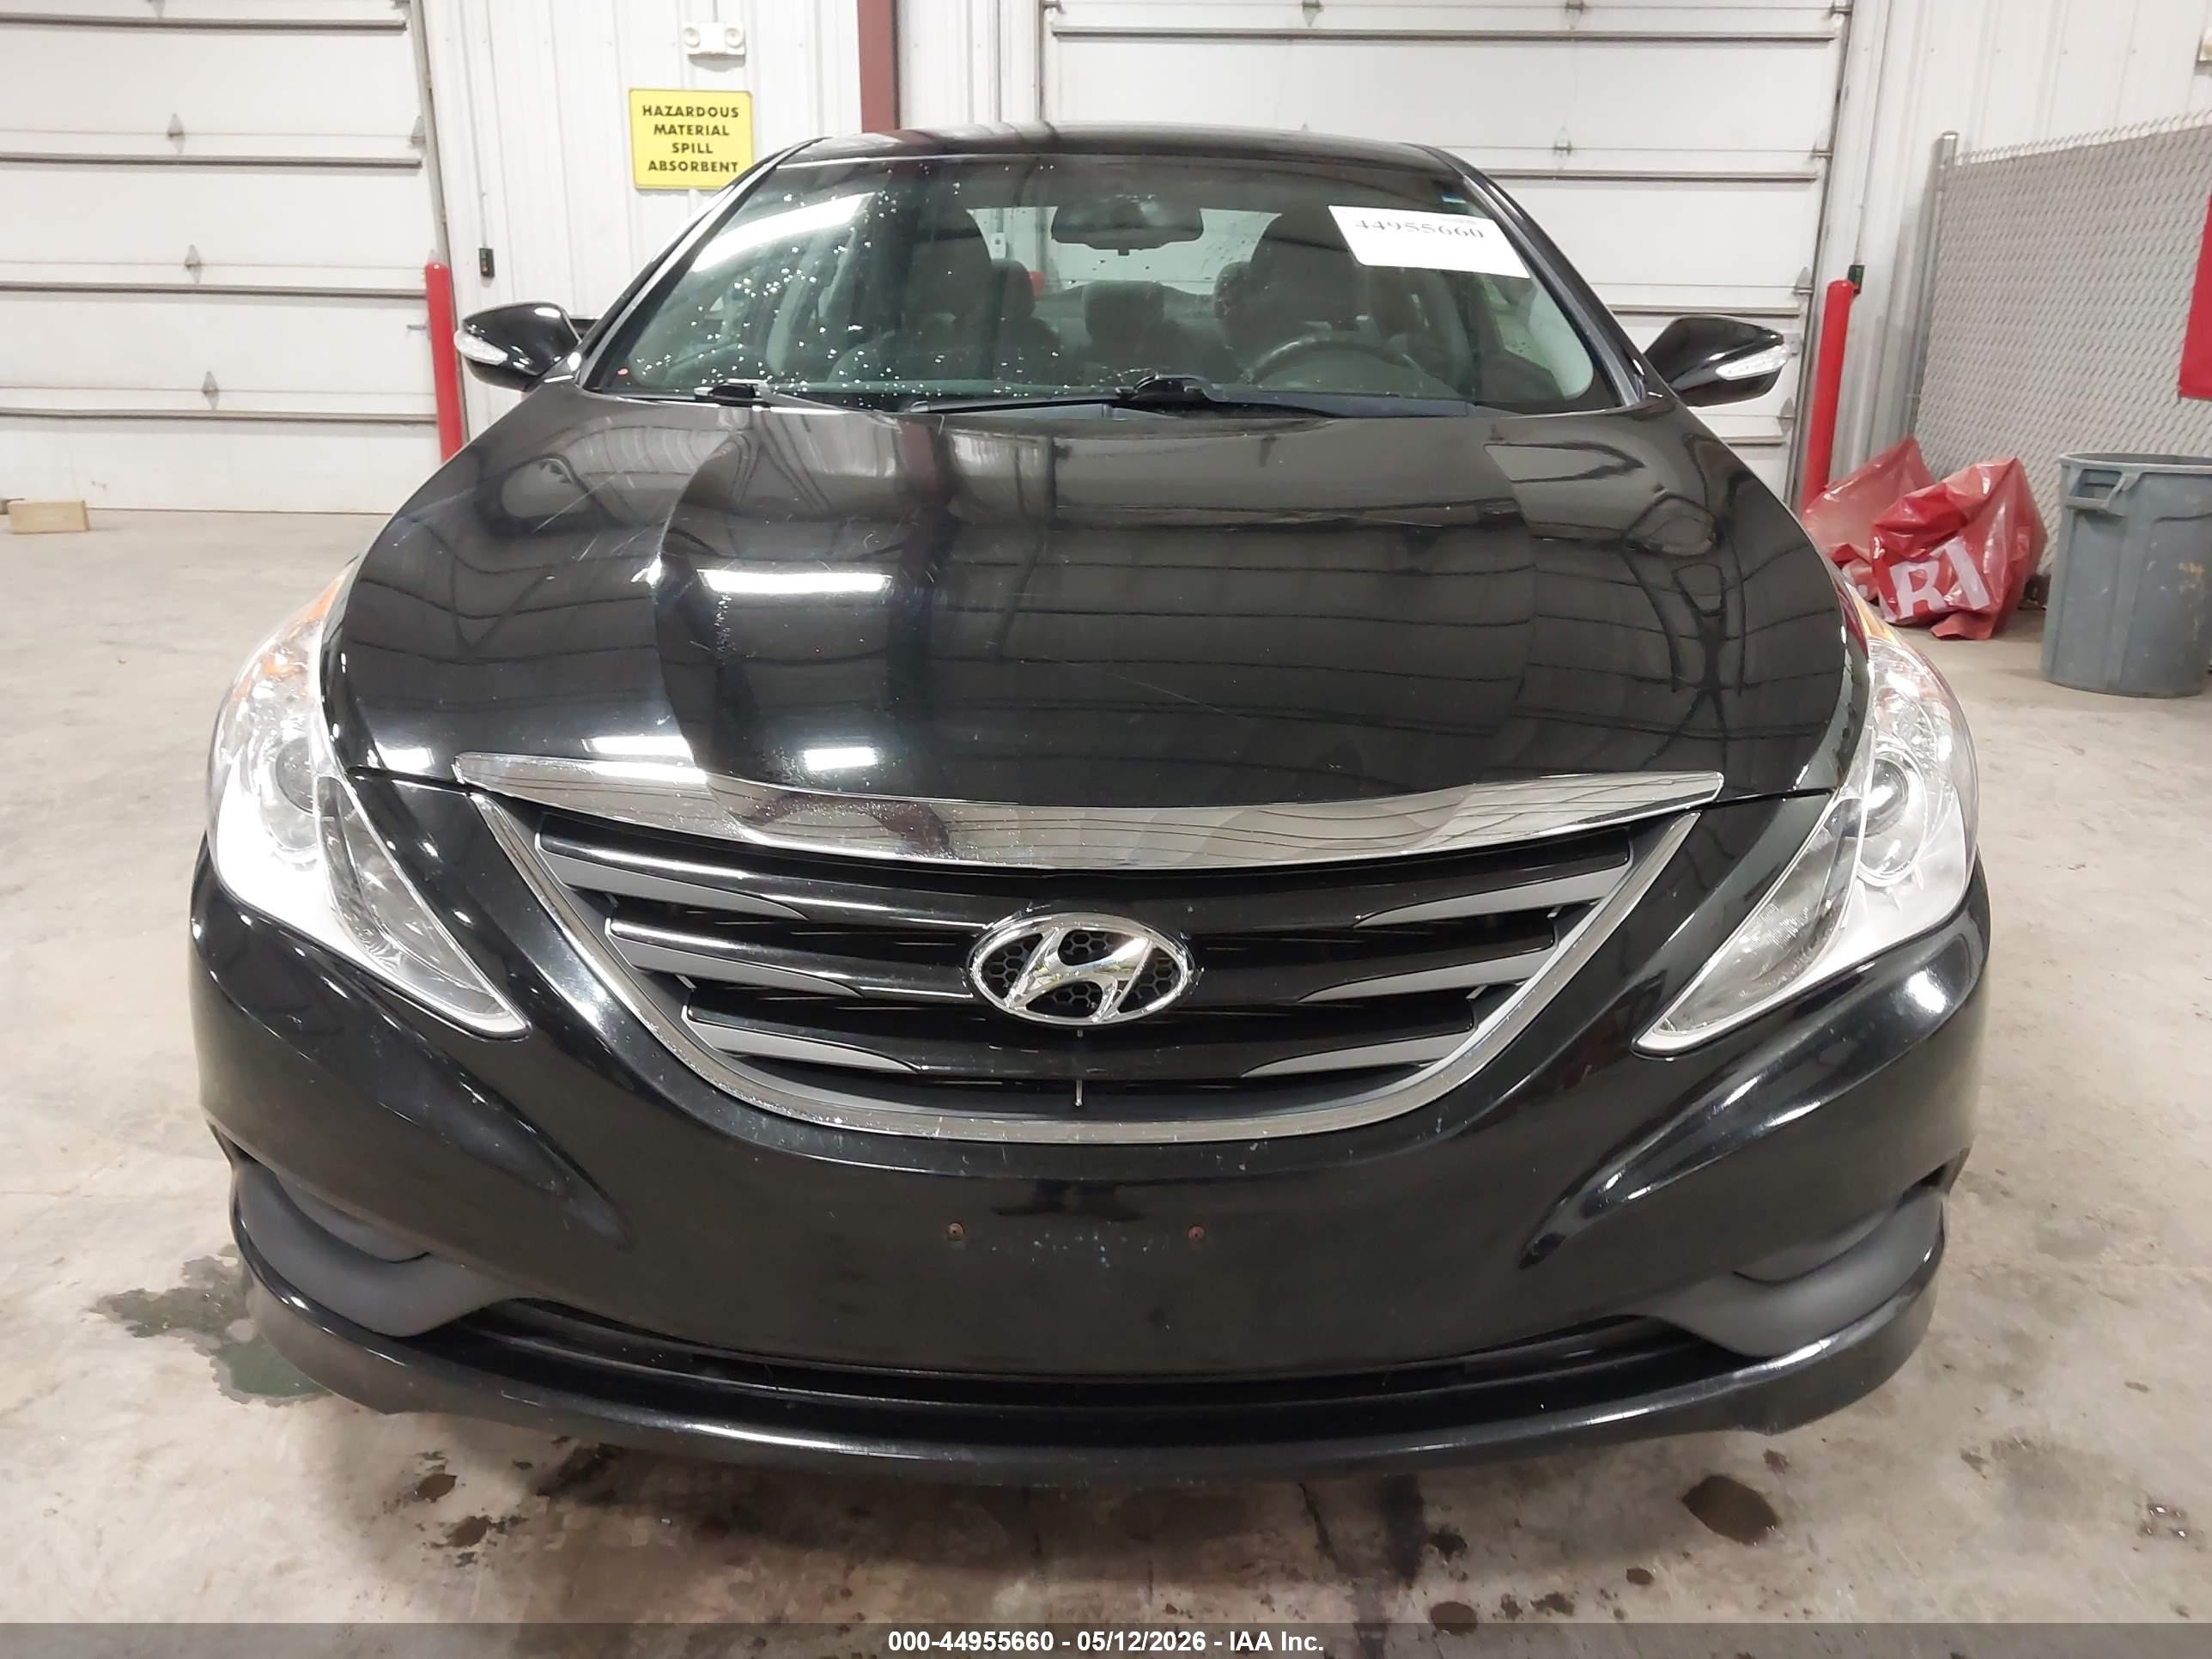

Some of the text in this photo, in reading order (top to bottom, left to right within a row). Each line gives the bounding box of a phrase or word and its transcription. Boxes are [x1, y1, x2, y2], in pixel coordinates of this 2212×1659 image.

[642, 105, 739, 118] HAZARDOUS
[653, 124, 730, 136] MATERIAL
[672, 143, 714, 154] SPILL
[647, 160, 739, 173] ABSORBENT
[1355, 219, 1485, 239] 44955660
